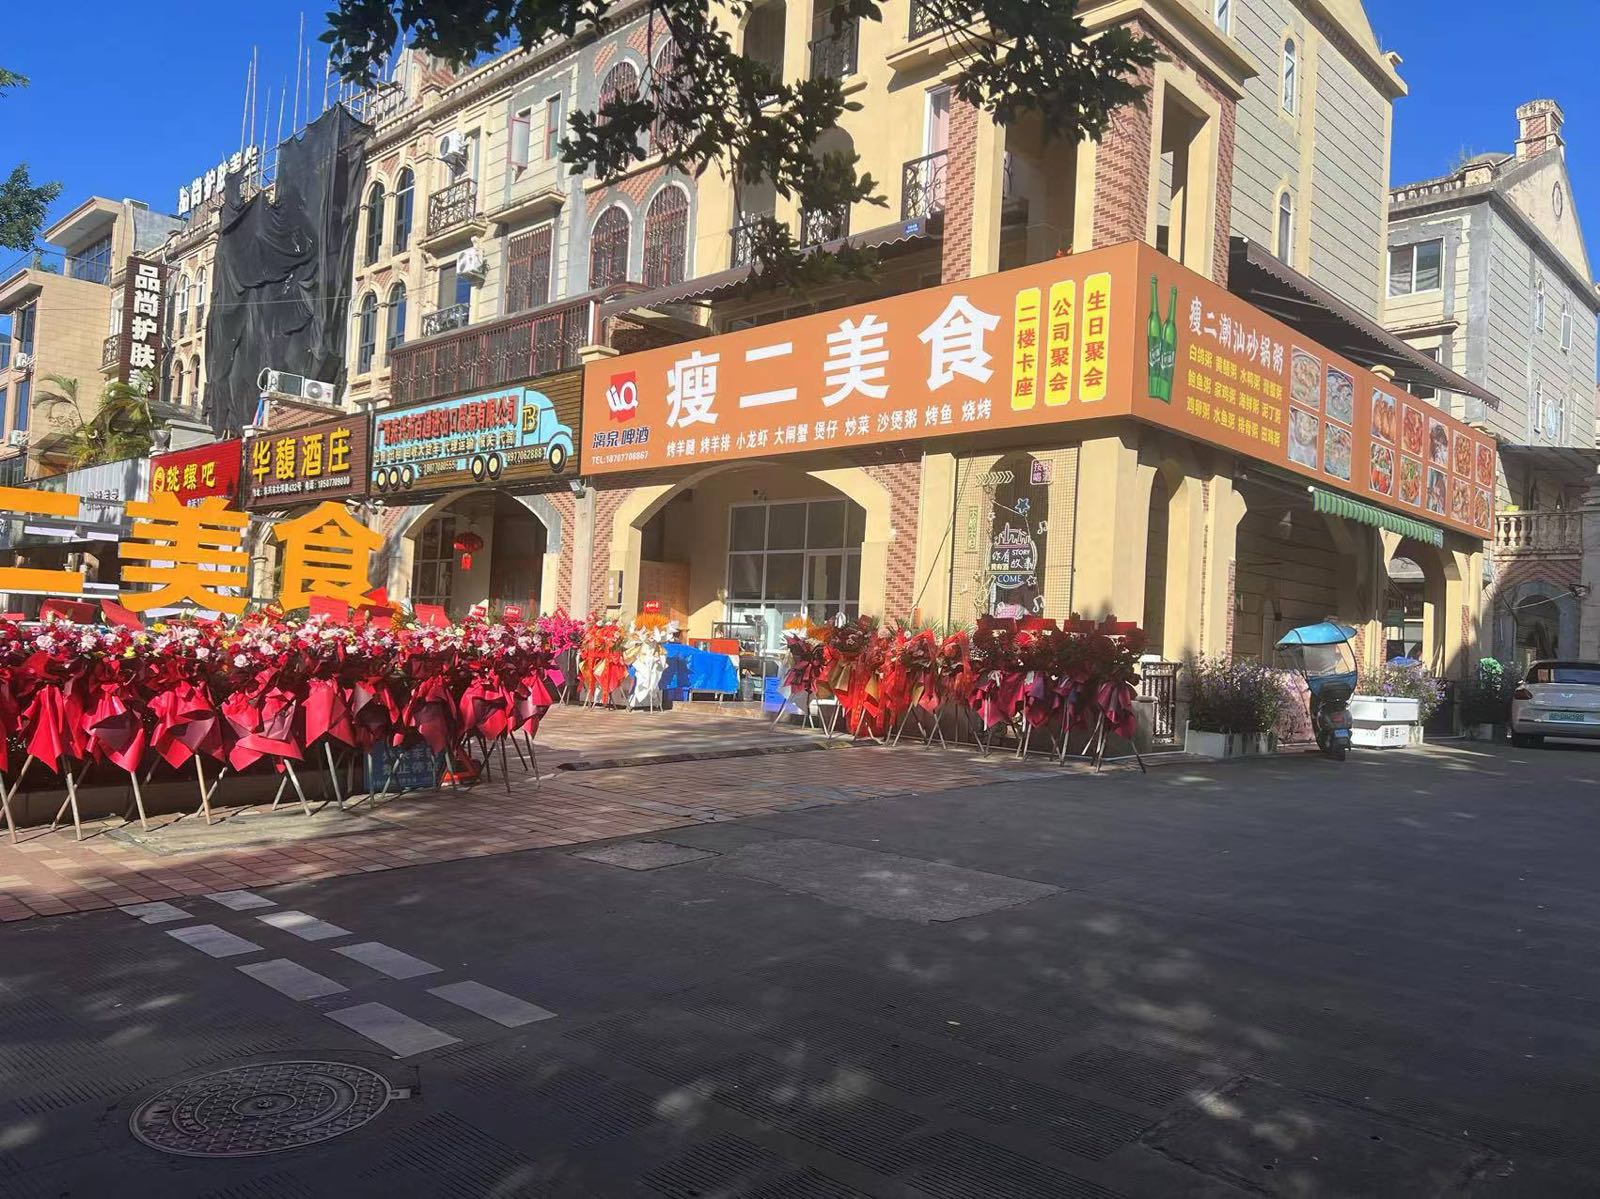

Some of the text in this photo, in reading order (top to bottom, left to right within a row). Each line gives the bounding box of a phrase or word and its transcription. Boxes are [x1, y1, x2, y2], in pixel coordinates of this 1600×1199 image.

[666, 295, 1001, 428] 瘦二美食
[1015, 305, 1037, 397] 二楼卡座
[1049, 298, 1072, 392] 公司聚会
[1083, 290, 1107, 388] 生日聚会
[252, 427, 351, 483] 华馥酒庄
[592, 426, 650, 448] 漓泉啤酒
[700, 434, 731, 454] 烤羊排
[736, 428, 768, 450] 小龙虾
[774, 423, 808, 445] 大闸蟹
[814, 419, 838, 440] 煲仔
[844, 415, 870, 436] 炒菜
[877, 408, 918, 433] 沙煲粥
[925, 405, 953, 426] 烤鱼
[961, 398, 992, 422] 烧烤
[997, 575, 1023, 583] COME
